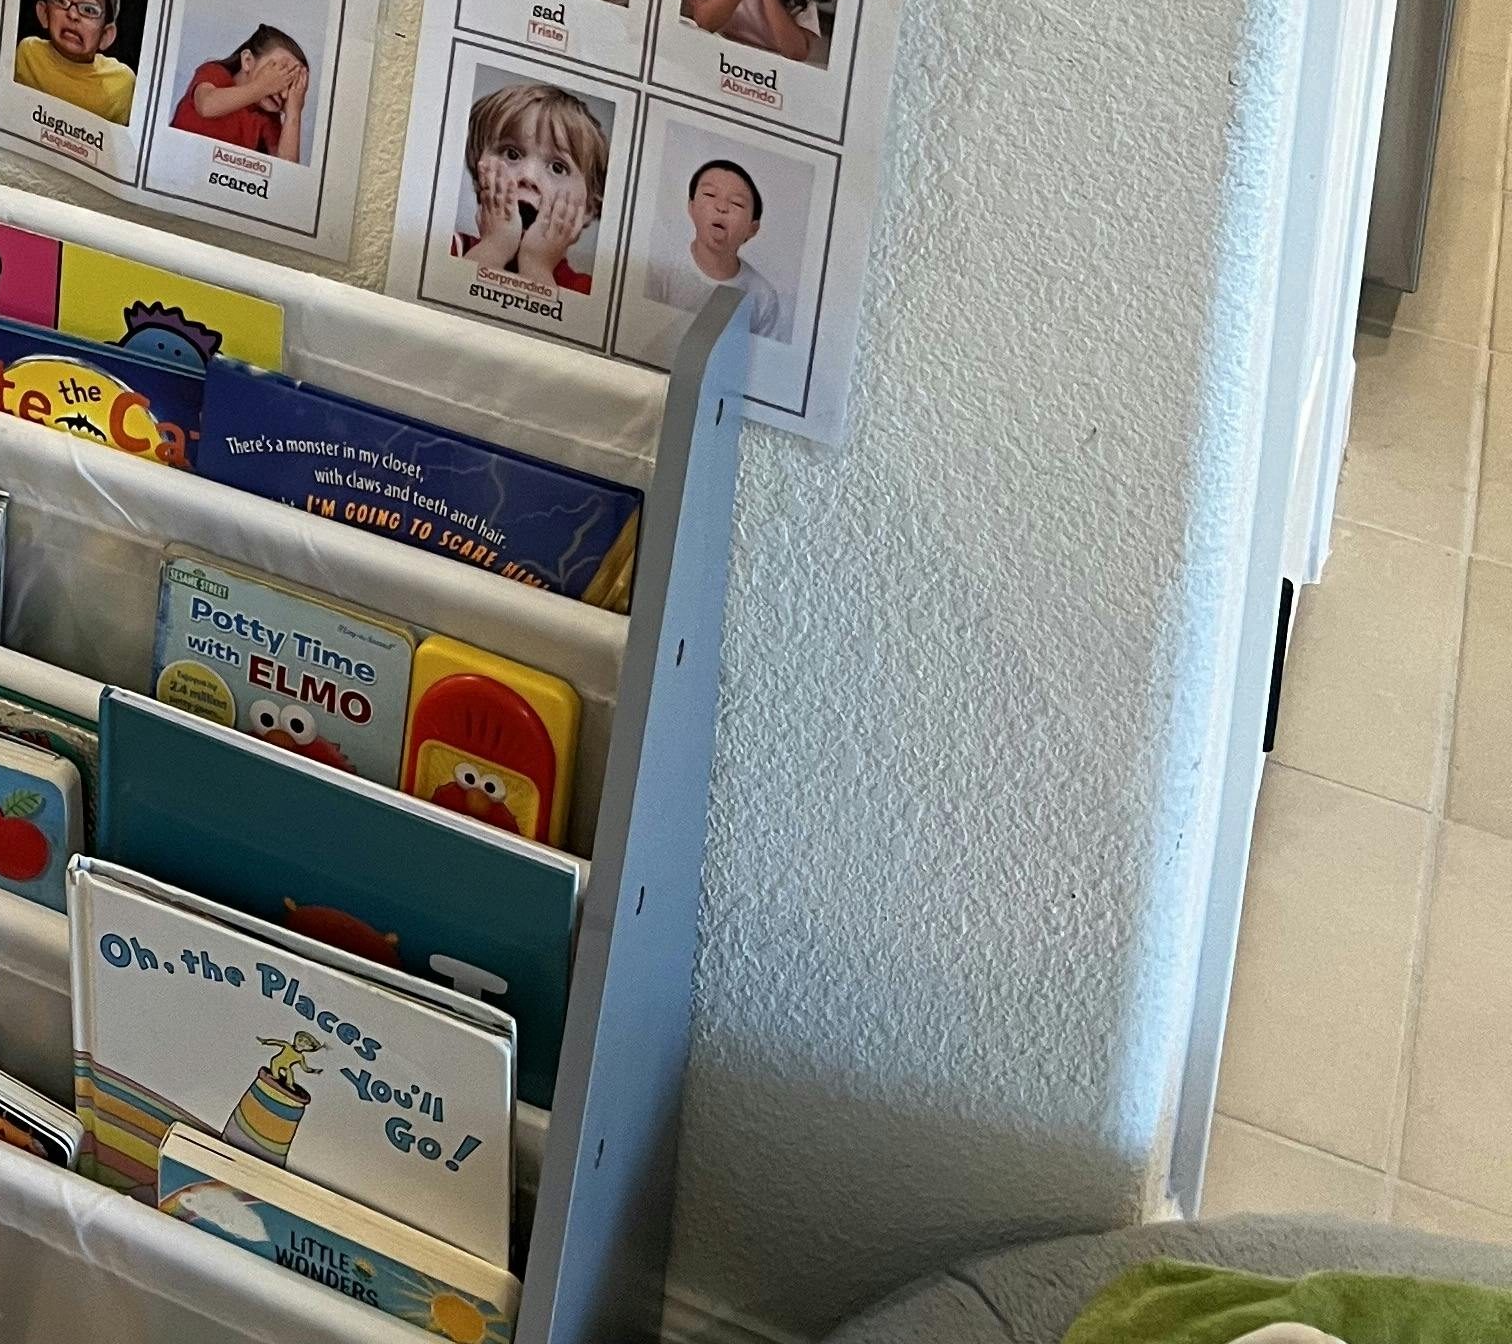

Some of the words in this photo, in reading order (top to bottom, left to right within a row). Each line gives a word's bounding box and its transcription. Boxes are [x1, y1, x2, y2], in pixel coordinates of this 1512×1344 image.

[530, 23, 563, 43] Triste
[532, 0, 565, 26] sad
[719, 53, 778, 92] bored
[722, 78, 776, 105] Aburrido
[32, 105, 104, 152] disgusted
[214, 148, 267, 174] Asustado
[209, 171, 269, 200] scared
[468, 281, 564, 322] surprised
[478, 265, 554, 298] Sorprendido
[58, 377, 101, 405] the
[109, 391, 201, 470] Ca
[225, 434, 273, 456] There's
[274, 439, 284, 453] a
[286, 438, 339, 458] monster
[343, 441, 356, 460] in
[359, 448, 380, 469] my
[382, 452, 425, 483] closet,
[306, 494, 336, 518] I'M
[345, 502, 401, 530] GOING
[409, 517, 433, 540] TO
[438, 530, 498, 567] SCARE
[314, 465, 343, 487] with
[346, 469, 381, 496] claws
[384, 480, 410, 503] and
[413, 491, 449, 517] teeth
[450, 509, 479, 531] and
[478, 519, 507, 550] hair.
[169, 567, 198, 590] SESAME
[199, 578, 228, 599] STREET
[191, 596, 287, 655] Potty
[292, 632, 376, 683] Time
[187, 634, 241, 666] with
[248, 653, 373, 726] ELMO
[99, 933, 175, 975] Oh,
[181, 948, 246, 988] the
[255, 962, 383, 1062] Places
[340, 1067, 444, 1123] You'll
[385, 1116, 483, 1172] Go!
[275, 1244, 379, 1308] WONDERS
[290, 1231, 351, 1275] LITTLE
